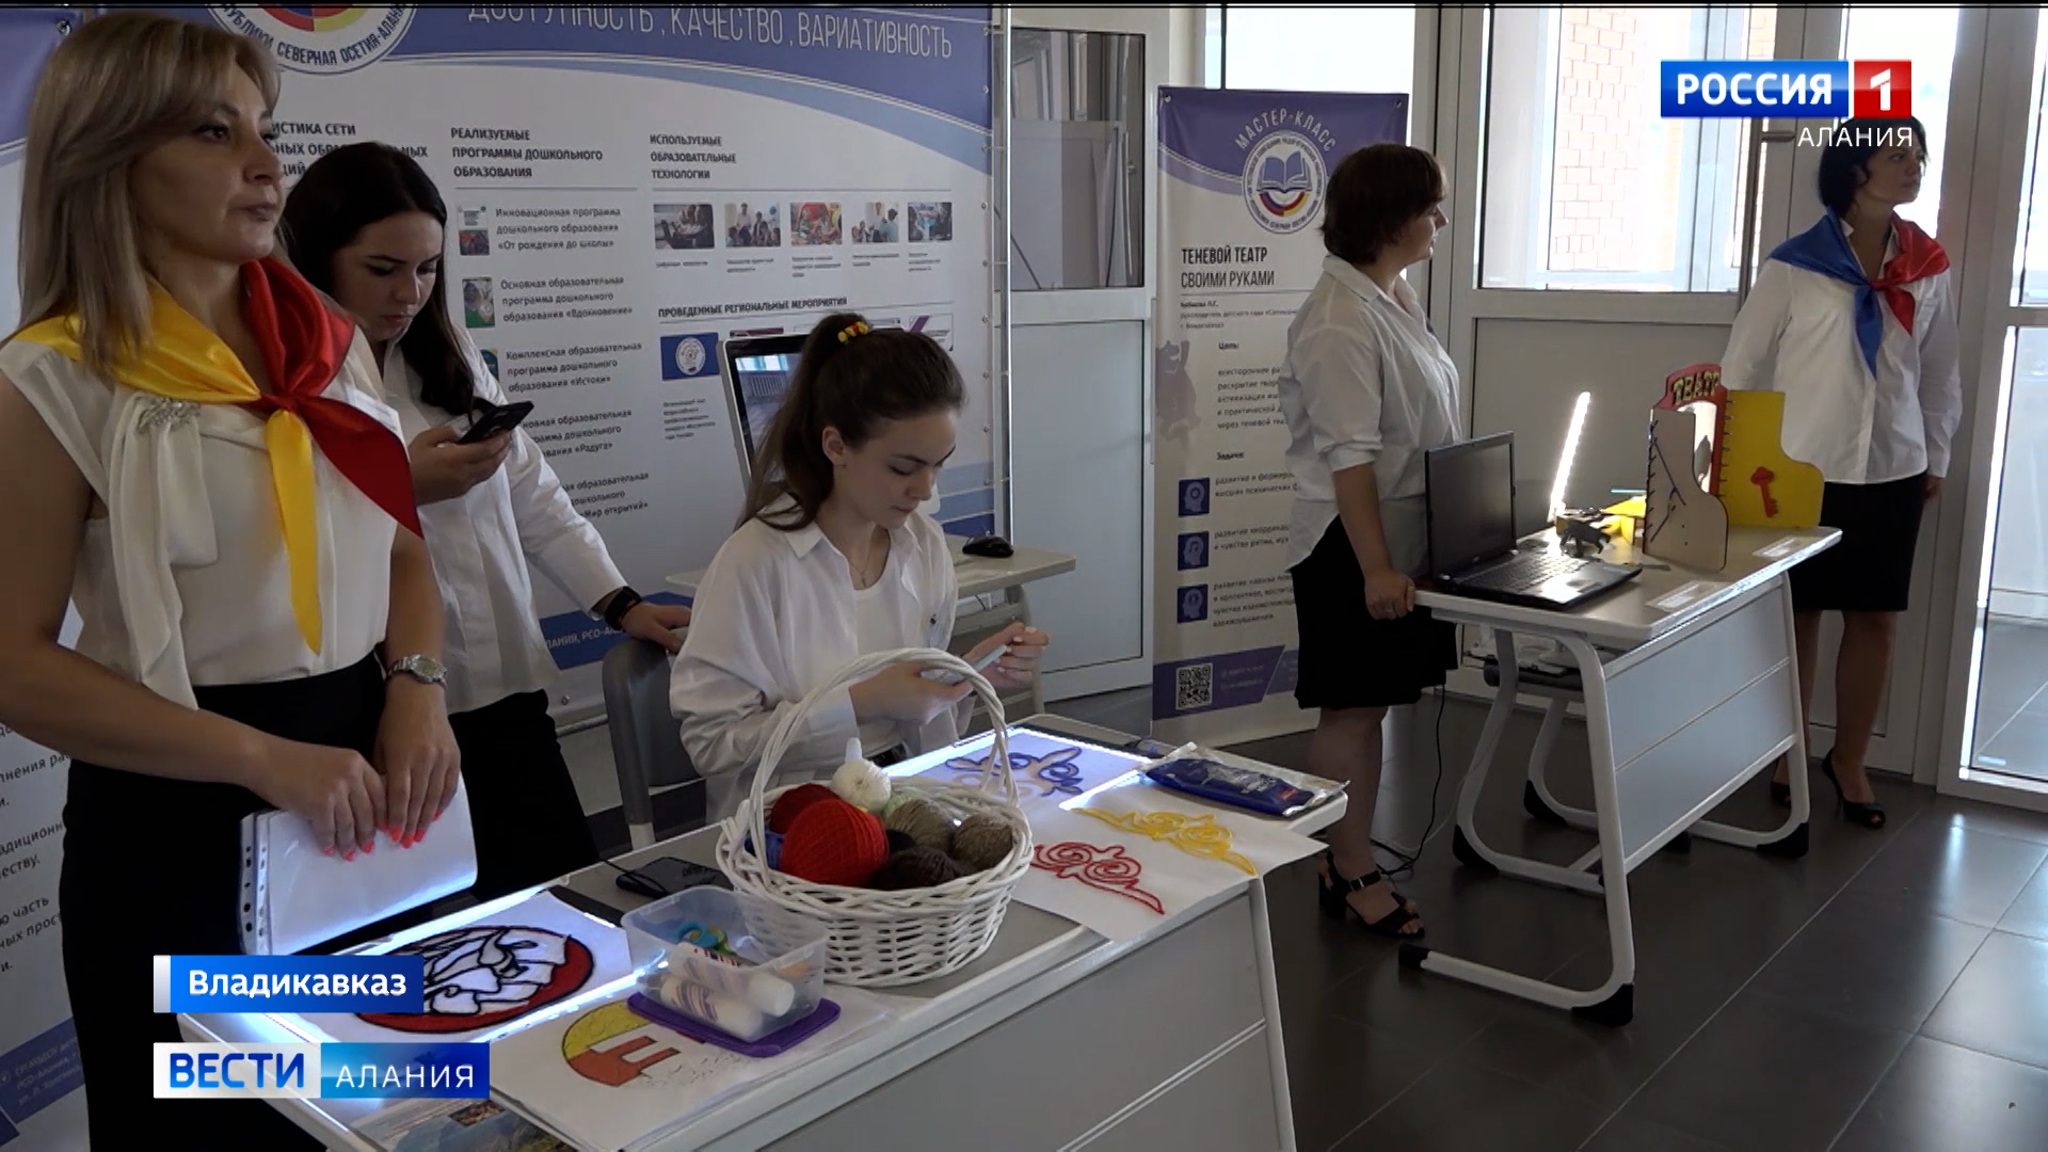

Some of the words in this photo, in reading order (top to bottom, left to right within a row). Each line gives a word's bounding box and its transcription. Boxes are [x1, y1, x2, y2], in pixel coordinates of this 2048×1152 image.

[799, 19, 952, 59] ВАРИАТИВНОСТЬ
[277, 41, 336, 65] СЕВЕРНАЯ
[325, 123, 356, 136] СЕТИ
[451, 128, 530, 141] РЕАЛИЗУЕМЫЕ
[1235, 108, 1336, 152] МАСТЕР-КЛАСС
[650, 134, 722, 147] ИСПОЛЬЗУЕМЫЕ
[453, 147, 522, 160] ПРОГРАММЫ
[525, 148, 604, 163] ДОШКОЛЬНОГО
[651, 152, 737, 165] ОБРАЗОВАТЕЛЬНЫЕ
[454, 167, 532, 180] ОБРАЗОВАНИЯ
[652, 169, 711, 181] ТЕХНОЛОГИИ
[496, 208, 570, 218] Инновационная
[573, 208, 621, 219] программа
[497, 224, 559, 235] дошкольного
[1181, 244, 1231, 265] ТЕНЕВОЙ
[1234, 246, 1268, 263] ТЕАТР
[501, 279, 546, 290] Основная
[549, 277, 624, 290] образовательная
[1181, 271, 1227, 288] СВОИМИ
[1230, 270, 1274, 287] РУКАМИ
[502, 295, 554, 306] программа
[555, 292, 613, 304] дошкольного
[658, 305, 723, 318] ПРОВЕДЕННЫЕ
[724, 301, 789, 314] РЕГИОНАЛЬНЫЕ
[791, 296, 848, 309] МЕРОПРИЯТИЯ
[503, 311, 563, 323] образования
[506, 349, 566, 361] Комплексная
[568, 342, 642, 357] образовательная
[507, 365, 558, 378] программа
[560, 359, 618, 373] дошкольного
[508, 381, 568, 393] образования
[557, 410, 632, 426] образовательная
[564, 425, 622, 442] дошкольного
[13, 897, 50, 918] часть
